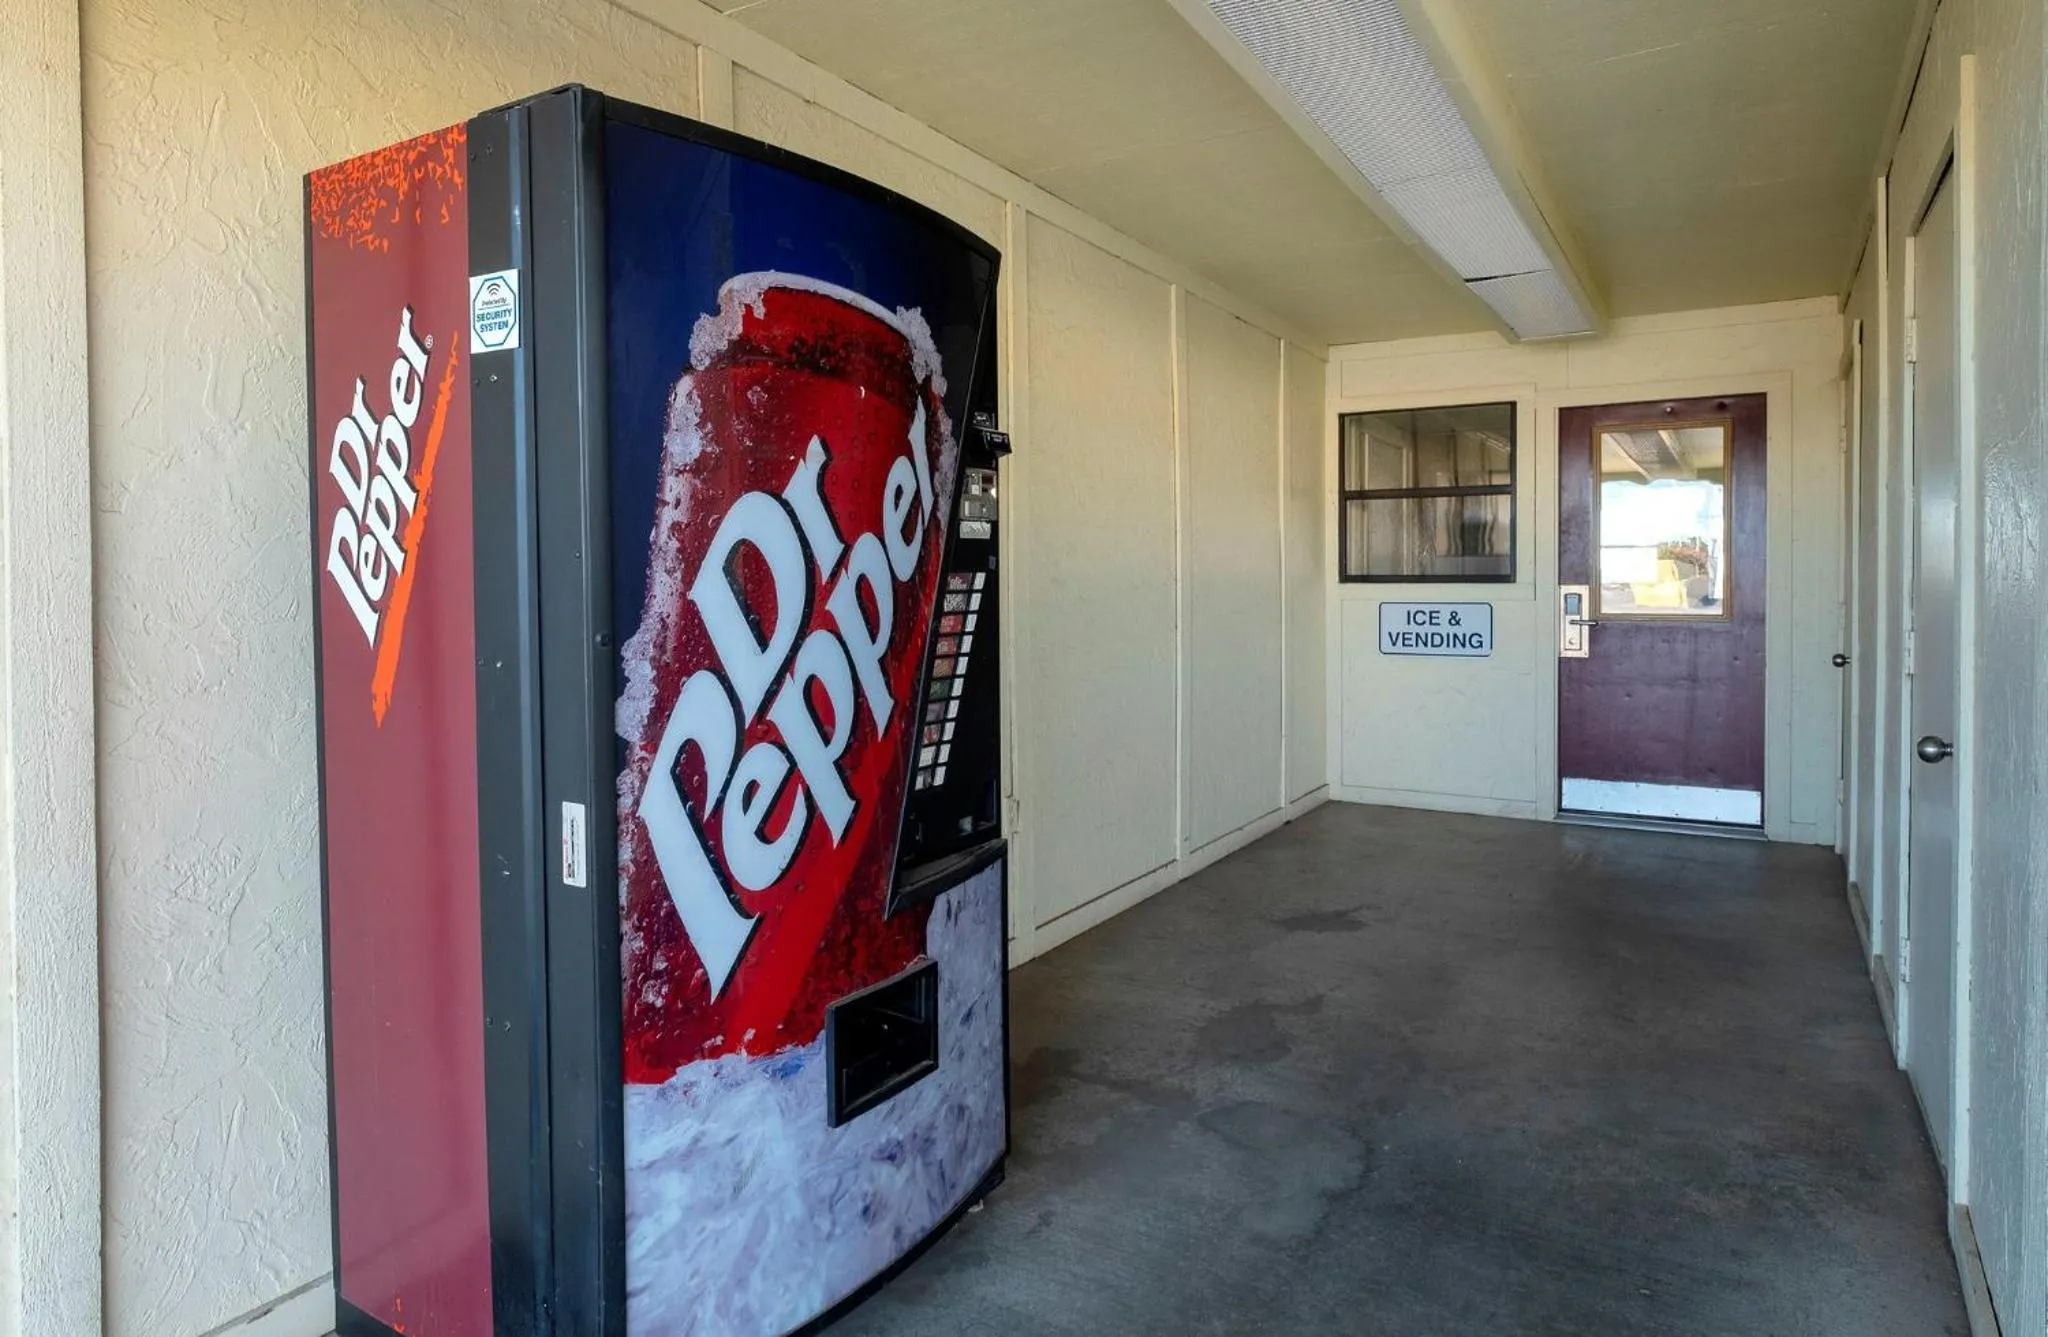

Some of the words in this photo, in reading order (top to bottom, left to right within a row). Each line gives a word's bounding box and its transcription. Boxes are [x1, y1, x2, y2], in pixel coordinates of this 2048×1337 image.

[476, 308, 512, 323] SECURITY
[480, 320, 509, 333] SYSTEM
[327, 303, 431, 650] Pepper
[329, 376, 380, 526] Dr
[688, 434, 846, 728] Dr
[1406, 609, 1441, 626] ICE
[1448, 610, 1462, 627] &
[1388, 631, 1484, 649] VENDING
[639, 396, 935, 1005] Pepper
